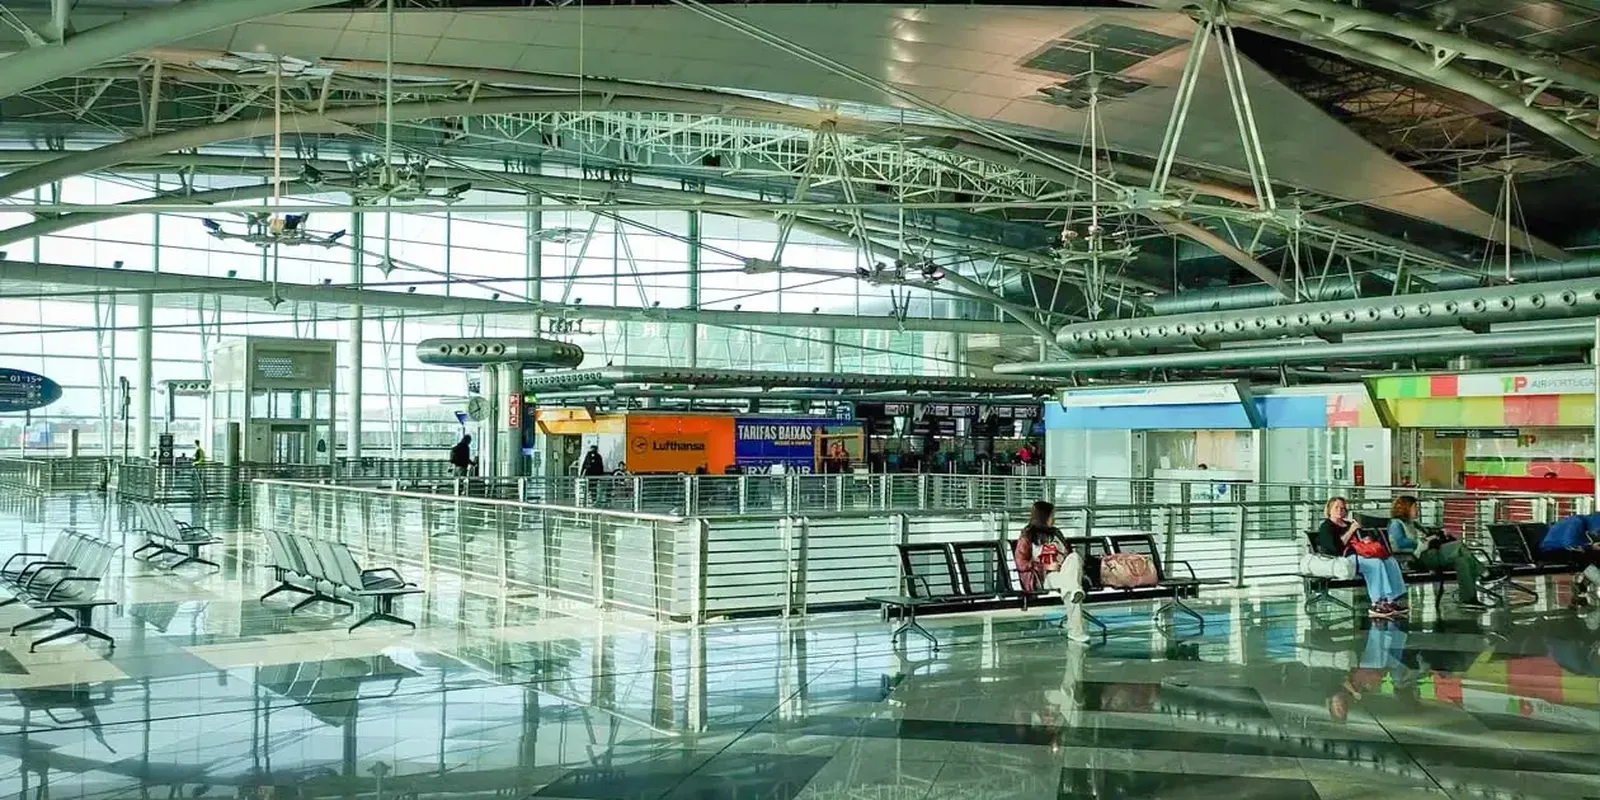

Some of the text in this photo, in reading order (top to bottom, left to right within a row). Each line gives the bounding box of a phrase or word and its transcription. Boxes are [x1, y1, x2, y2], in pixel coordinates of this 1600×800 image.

[1501, 376, 1528, 392] TP
[899, 404, 909, 414] 01
[965, 405, 976, 416] 03
[738, 425, 813, 440] TARIFAS BAIXAS
[653, 440, 705, 451] Lufthansa
[747, 465, 811, 475] RYAAIR
